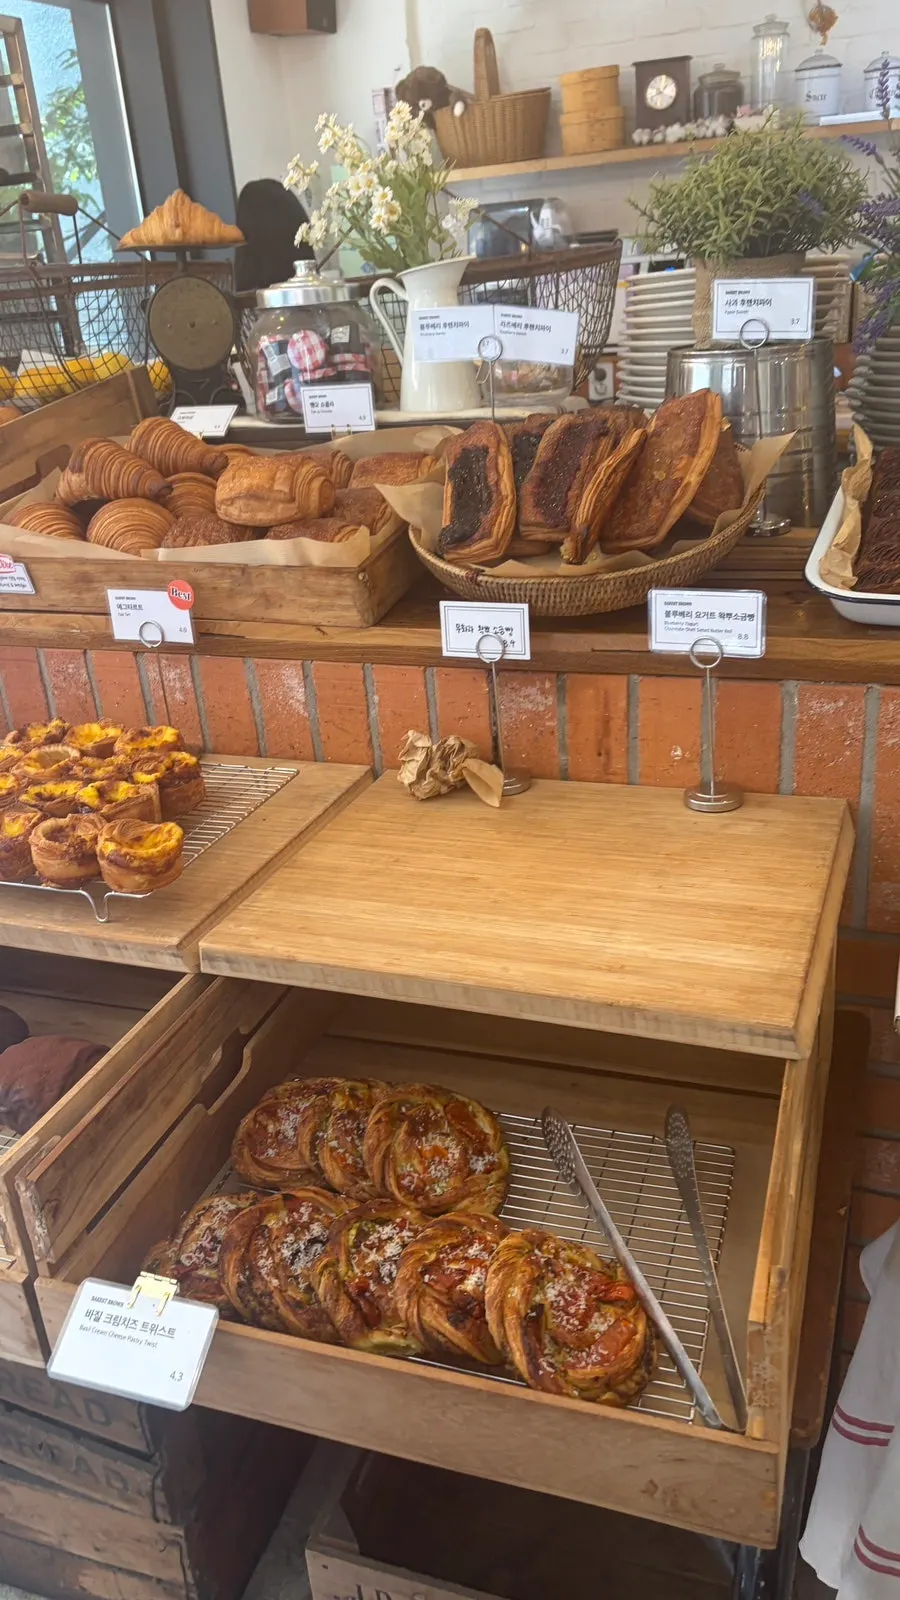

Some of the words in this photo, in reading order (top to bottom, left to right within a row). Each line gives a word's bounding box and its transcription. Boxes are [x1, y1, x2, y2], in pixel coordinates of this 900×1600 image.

[171, 586, 192, 602] Best
[664, 609, 693, 619] 블루베리
[694, 610, 717, 620] 요거트
[84, 1308, 103, 1323] 바질
[103, 1313, 139, 1330] 크림치즈
[139, 1321, 177, 1339] 트위스트
[170, 1370, 184, 1382] 4.3
